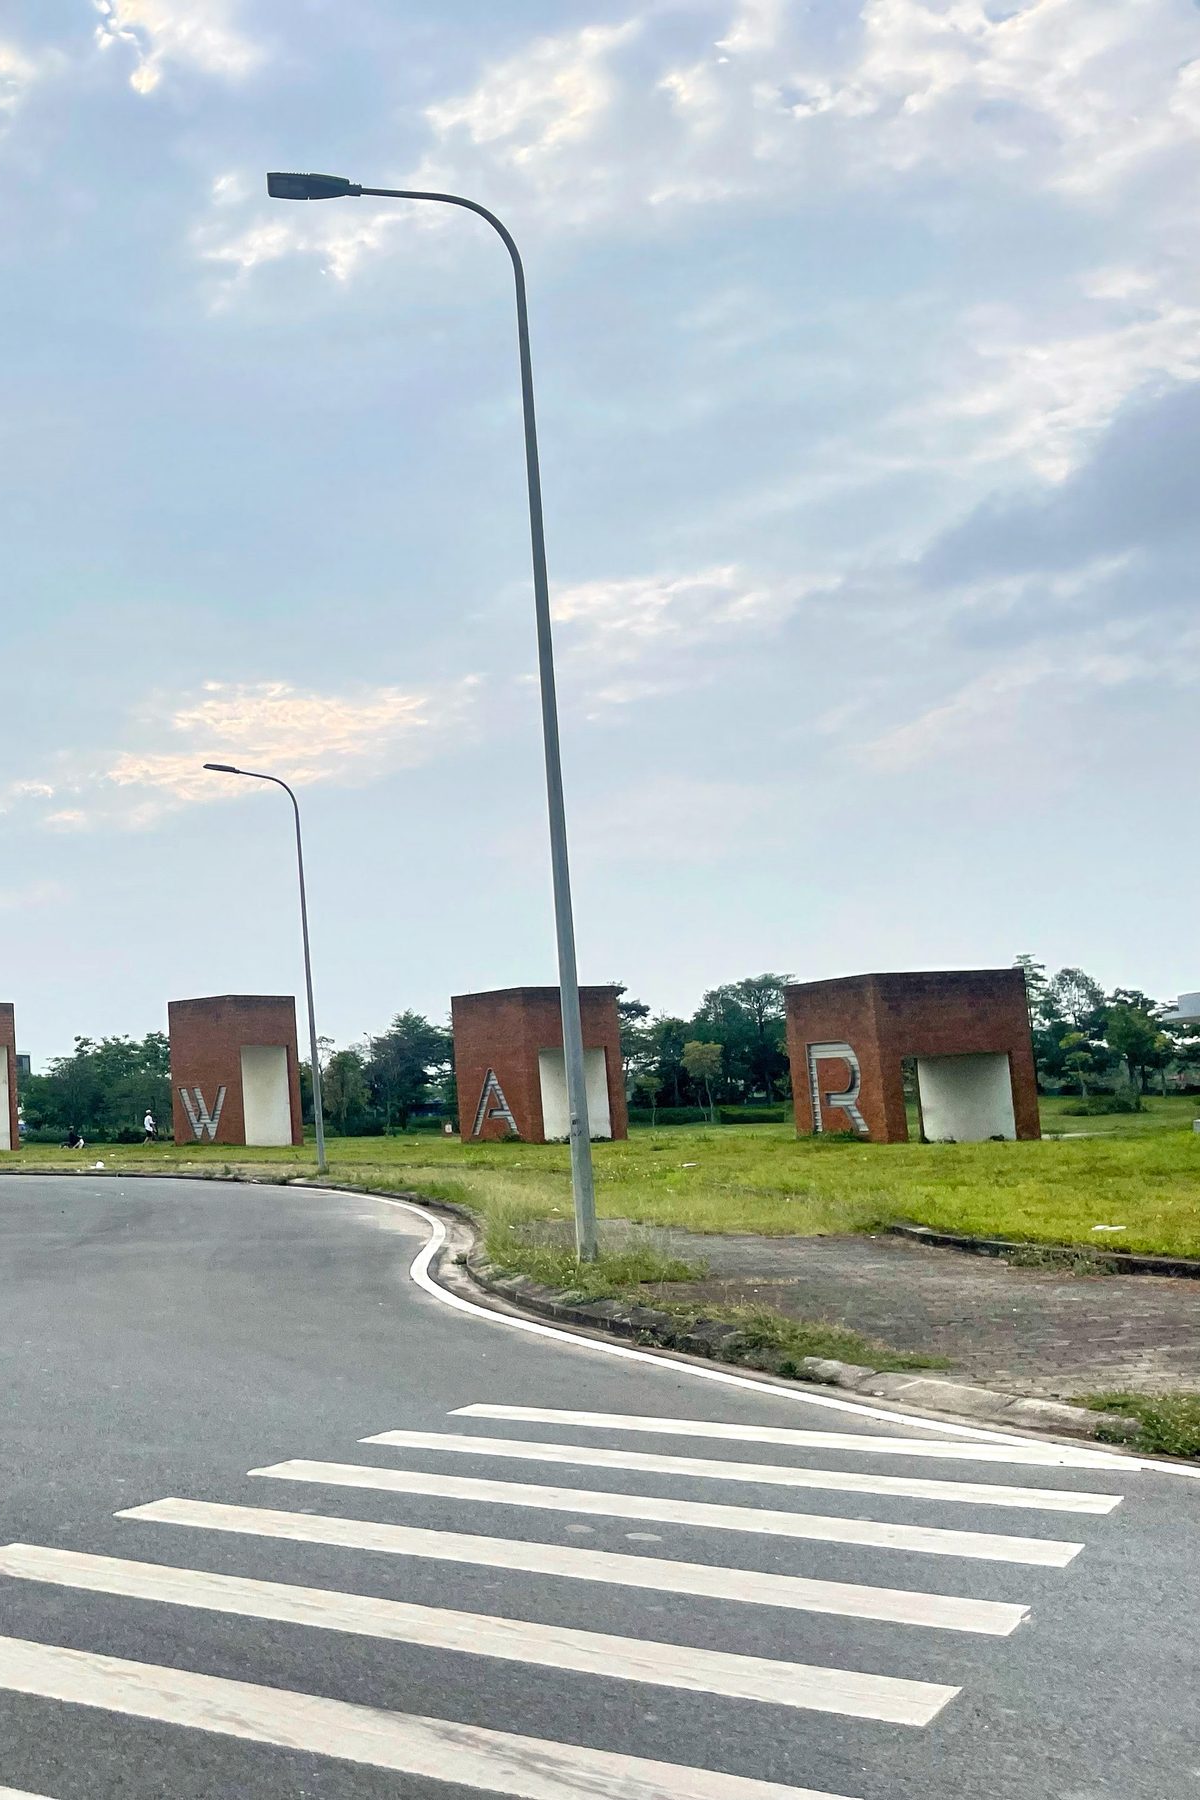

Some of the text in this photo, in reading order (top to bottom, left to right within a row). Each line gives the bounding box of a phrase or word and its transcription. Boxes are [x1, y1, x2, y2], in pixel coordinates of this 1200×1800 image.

[178, 1086, 227, 1140] W
[472, 1067, 520, 1137] A
[806, 1041, 870, 1133] R
